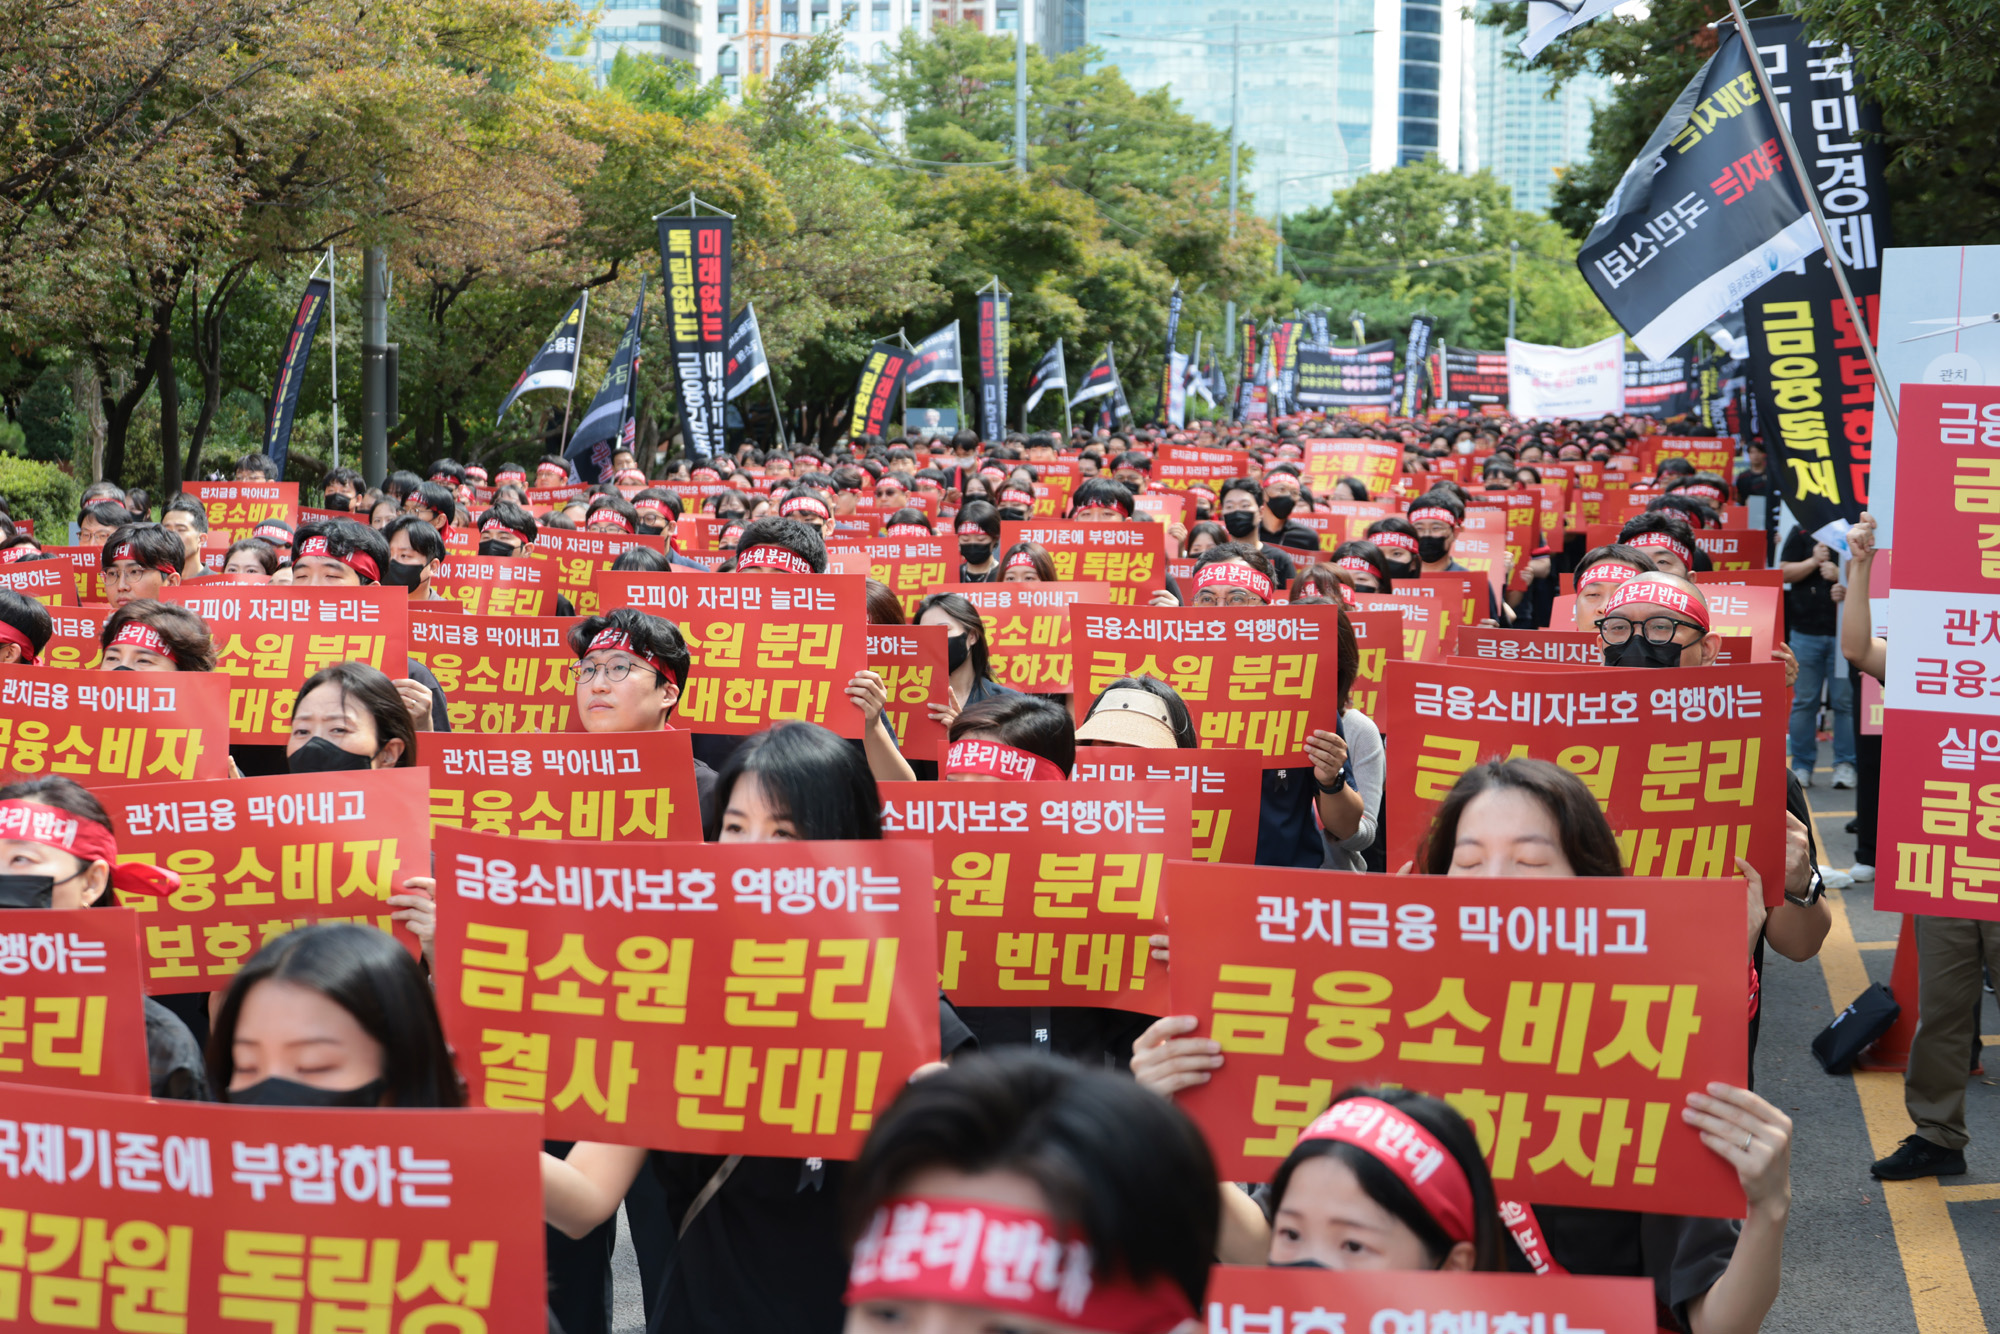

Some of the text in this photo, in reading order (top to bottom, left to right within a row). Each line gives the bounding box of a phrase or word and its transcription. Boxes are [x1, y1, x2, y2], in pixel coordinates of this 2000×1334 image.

[668, 229, 699, 342] 독립없는
[698, 229, 723, 342] 미래없는
[1939, 368, 1968, 383] 관치
[1310, 455, 1397, 475] 금소원 분리
[200, 487, 280, 499] 관치금융 막아내고
[202, 502, 289, 524] 융소비자
[566, 537, 604, 554] 자리만
[608, 540, 647, 555] 늘리
[865, 543, 942, 558] 자리만 늘리는
[1019, 529, 1144, 546] 국제기준에 부합하는
[1694, 539, 1739, 554] 아내고
[455, 563, 495, 580] 자리만
[499, 565, 541, 583] 늘리는
[739, 547, 766, 570] 금소원
[766, 548, 791, 568] 분리
[1082, 552, 1155, 582] 독립성
[1352, 558, 1370, 570] 반대
[898, 562, 946, 591] 분리
[1197, 565, 1270, 597] 금소원 분리 반대
[1579, 565, 1609, 589] 금소원
[249, 599, 380, 623] 자리만 늘리는
[487, 588, 544, 617] 분리
[627, 584, 836, 611] 모피아 자리만 늘리는
[1626, 583, 1689, 613] 분리 반대
[1705, 596, 1749, 616] 리는
[52, 617, 96, 639] 치금융
[118, 623, 143, 644] 분리
[412, 622, 560, 648] 관치금융 막아내고
[1086, 615, 1320, 643] 금융소비자보호 역행하는
[210, 634, 387, 680] 소원 분리
[757, 623, 844, 670] 분리
[1228, 653, 1319, 701] 분리
[2, 678, 70, 711] 관치금융
[77, 686, 177, 713] 막아내고
[679, 676, 832, 724] 대한다!
[1413, 681, 1763, 727] 금융소비자보호 역행하는
[447, 700, 570, 733] 호하자!
[443, 748, 642, 776] 관치금융 막아내고
[963, 741, 1037, 782] 분리 반대
[1414, 733, 1762, 813] 금원 분리
[125, 790, 367, 836] 관치금융 막아내고
[879, 800, 1167, 835] 소비자보호 역행하는
[32, 811, 79, 850] 반대
[454, 853, 719, 912] 금융소비자보호
[731, 866, 902, 915] 역행하는
[1033, 853, 1165, 920] 분리
[1255, 895, 1649, 957] 관치금융 막아내고
[459, 921, 695, 1025] 금소원
[724, 936, 900, 1030] 분리
[995, 931, 1151, 992] 반대!
[1210, 963, 1702, 1081] 금융소비자
[479, 1026, 884, 1136] 결사 반대!
[1242, 1074, 1671, 1188] 보하자!
[1374, 1116, 1444, 1186] 반대
[231, 1141, 454, 1209] 부합하는
[880, 1200, 986, 1291] 분리
[217, 1229, 500, 1334] 독립성
